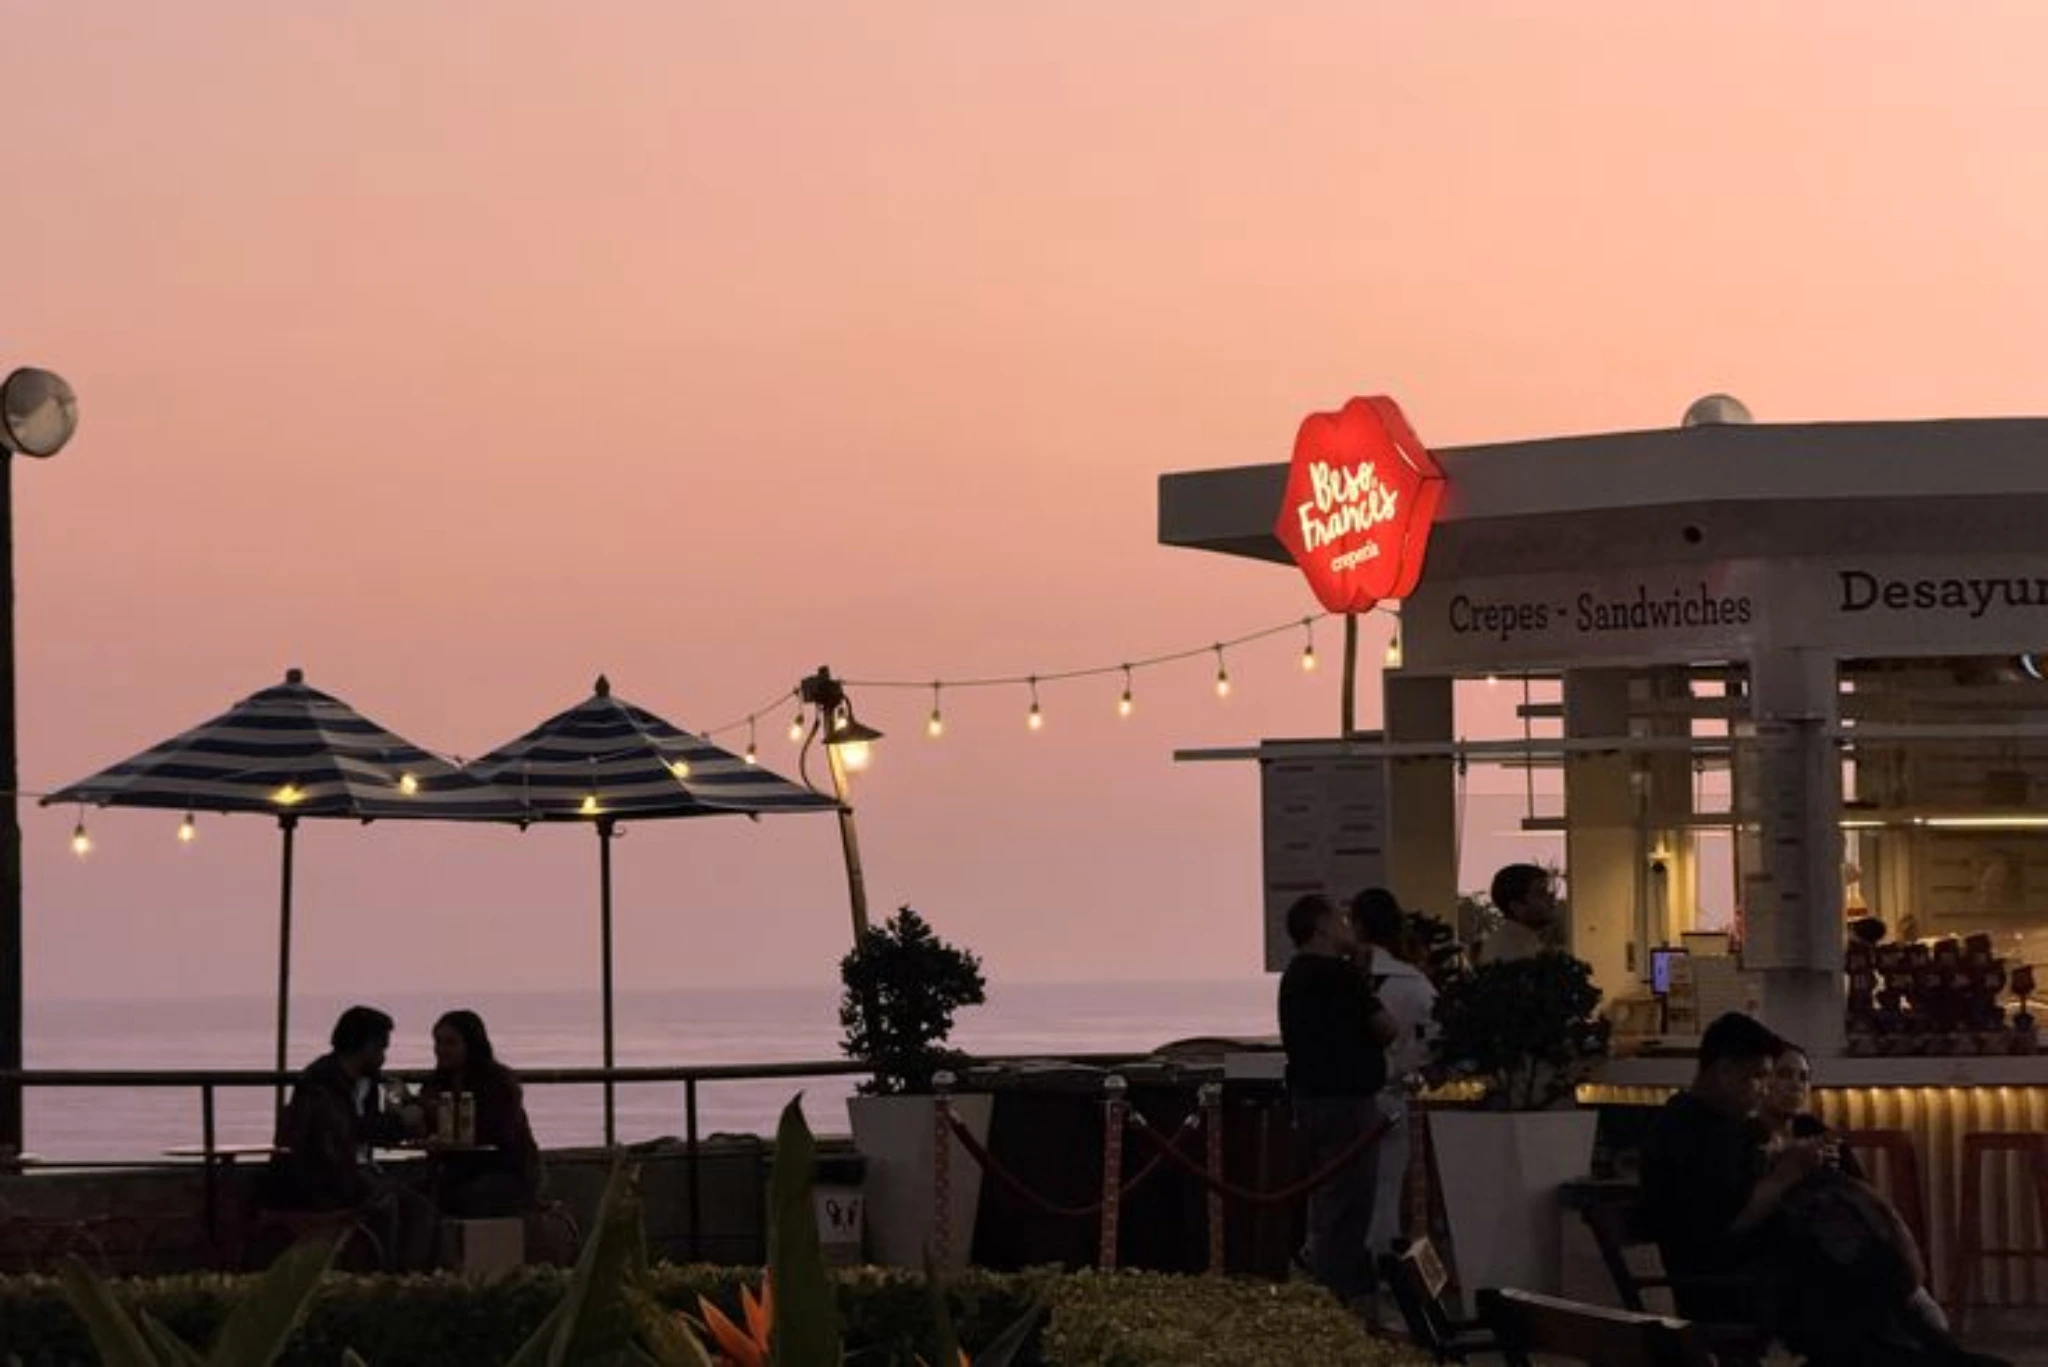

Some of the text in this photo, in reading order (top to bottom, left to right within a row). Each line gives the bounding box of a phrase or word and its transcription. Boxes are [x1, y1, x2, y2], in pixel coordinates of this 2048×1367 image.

[1309, 461, 1375, 513] Beso
[1449, 595, 1549, 641] Crepes
[1576, 582, 1753, 632] Sandwiches
